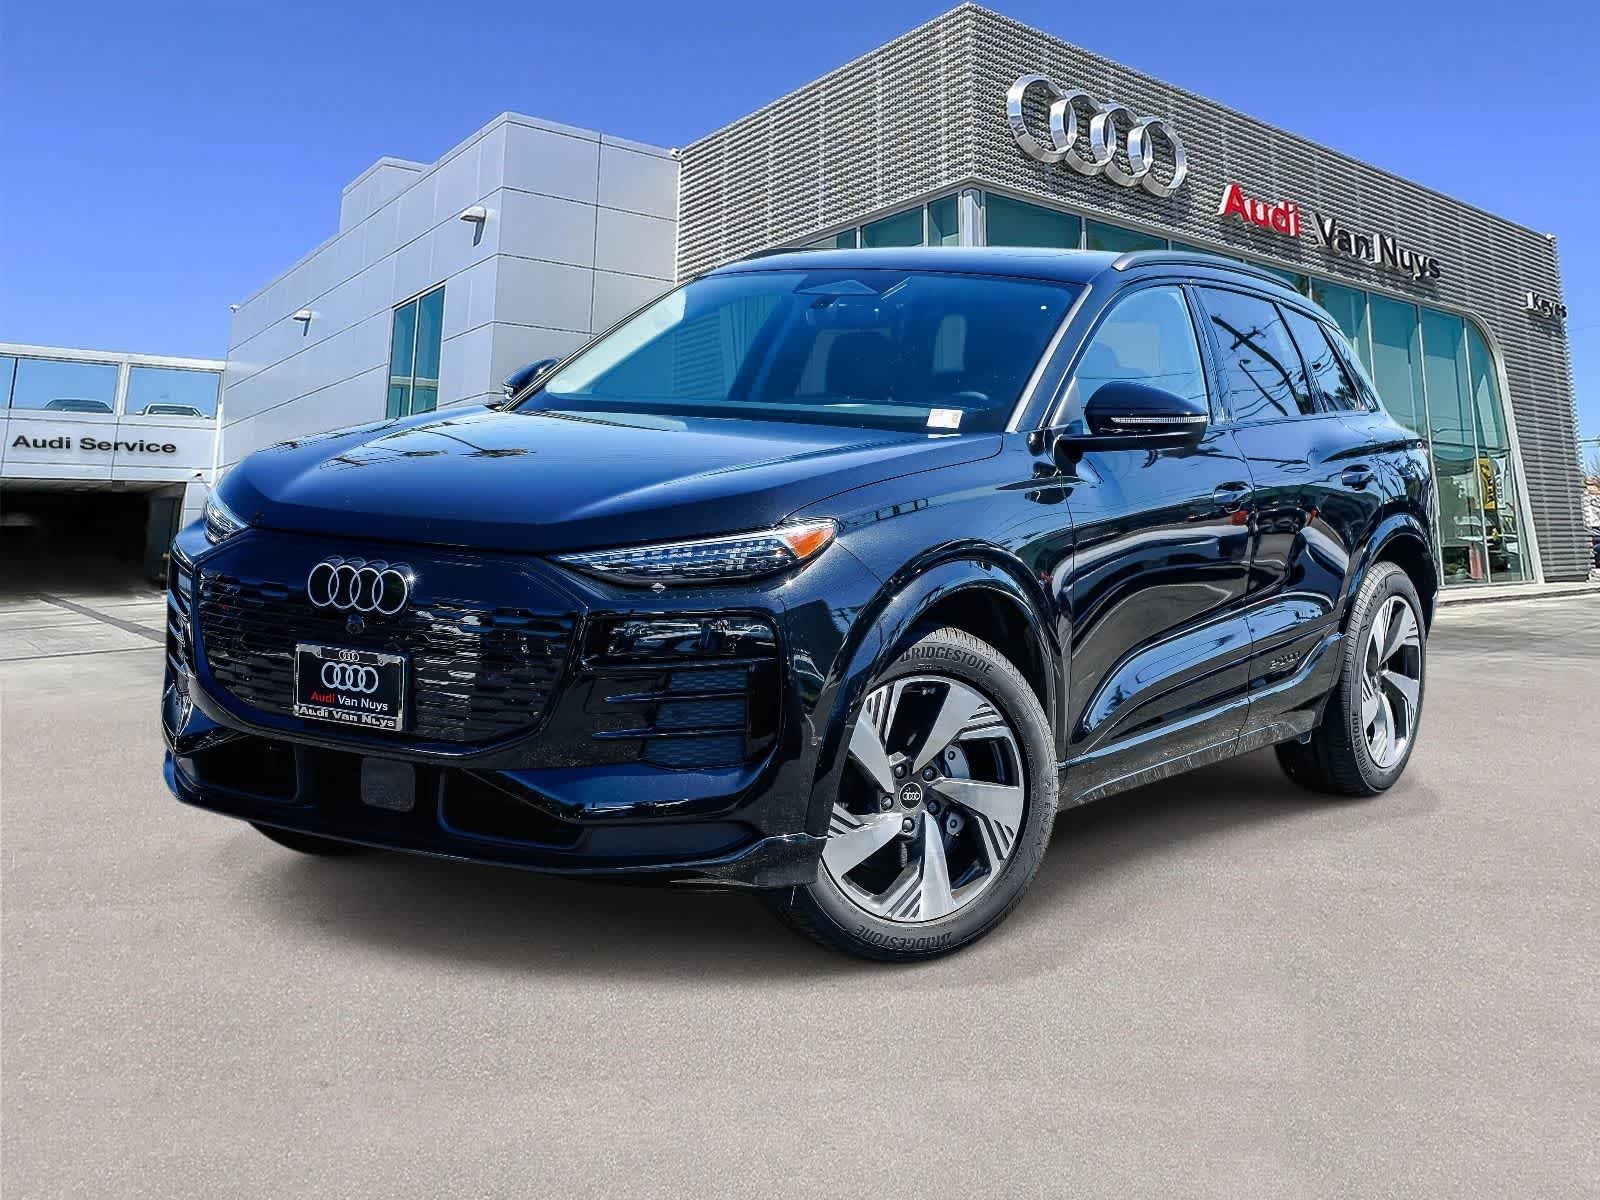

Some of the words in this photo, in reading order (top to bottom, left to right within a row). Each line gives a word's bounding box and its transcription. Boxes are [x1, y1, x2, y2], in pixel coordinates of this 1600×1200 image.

[1218, 183, 1301, 237] Audi
[1312, 212, 1372, 260] Van
[1373, 233, 1442, 281] Nuys
[12, 434, 71, 450] Audi
[79, 437, 178, 454] Service
[901, 645, 995, 676] BRIDGESTONE
[310, 690, 337, 704] Audi
[337, 694, 359, 707] Van
[360, 698, 389, 712] Nuys
[299, 705, 329, 718] Audi
[332, 710, 359, 722] Van
[361, 714, 396, 728] Nuys
[853, 924, 953, 950] BRIDGESTONE
